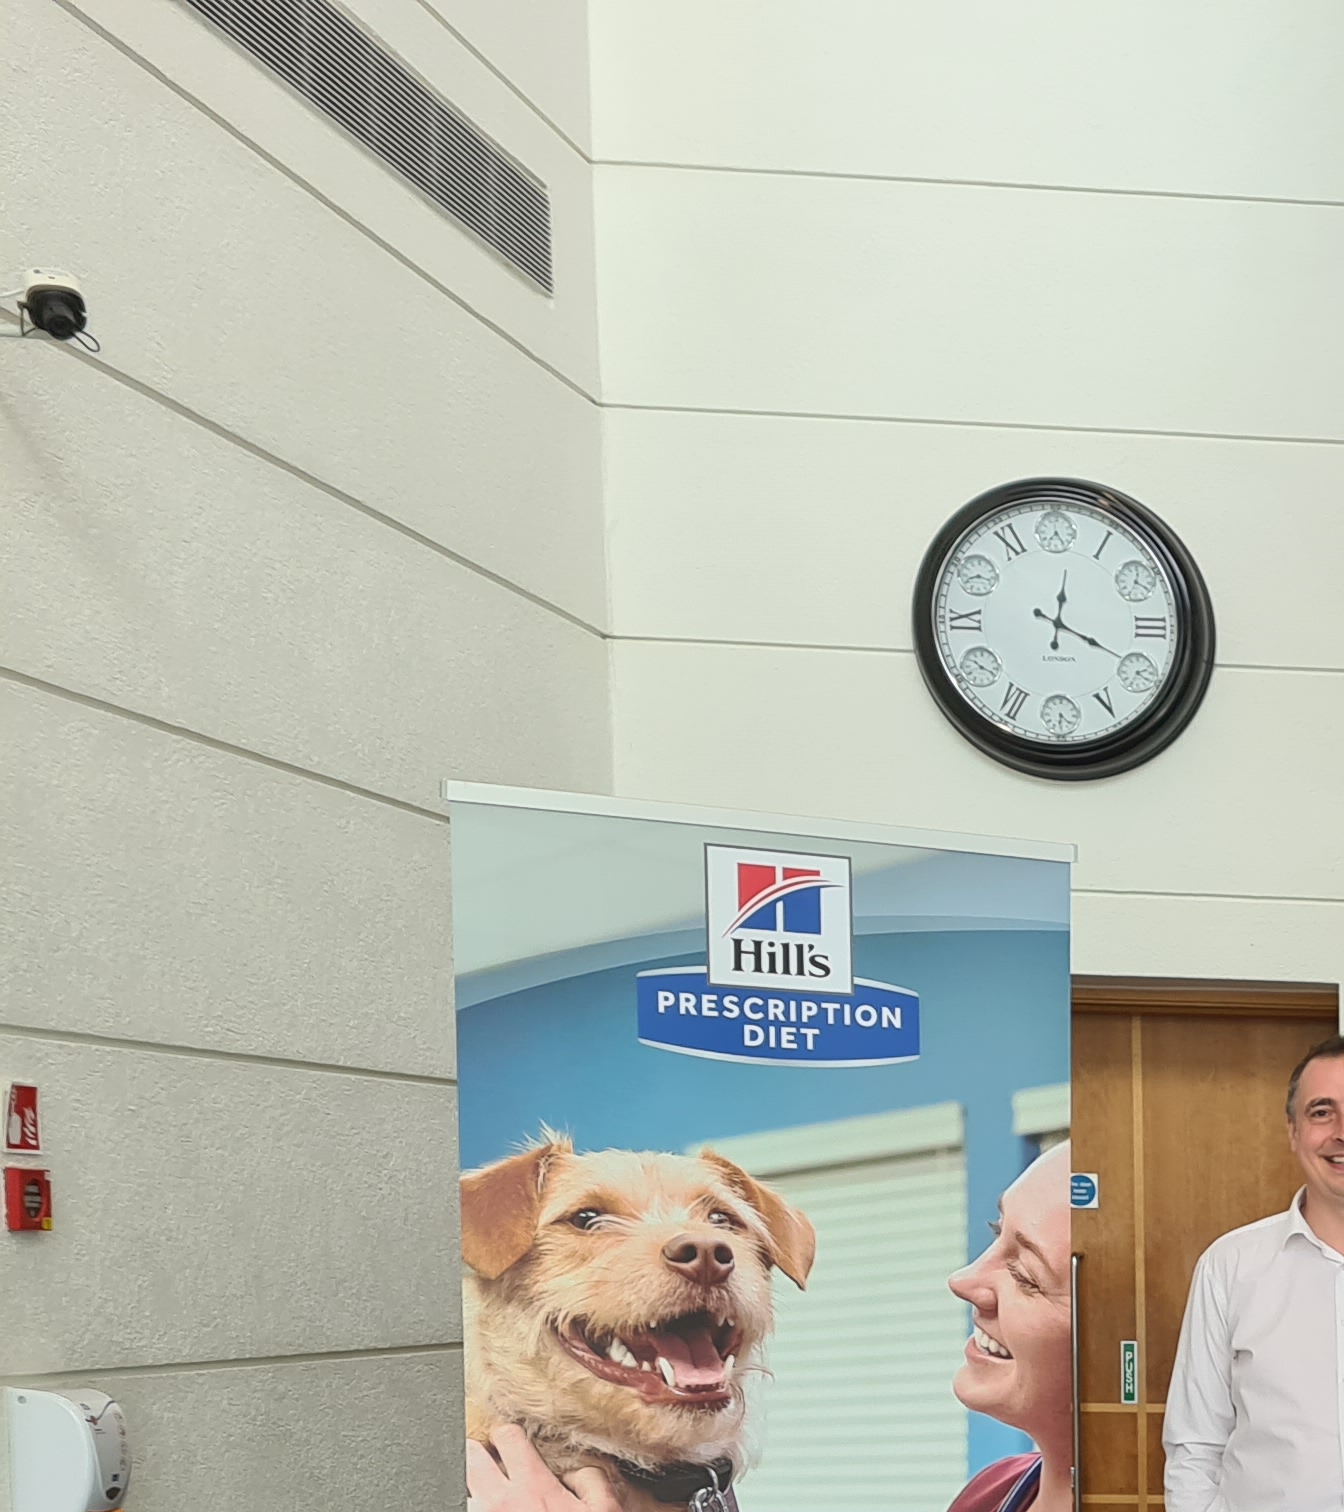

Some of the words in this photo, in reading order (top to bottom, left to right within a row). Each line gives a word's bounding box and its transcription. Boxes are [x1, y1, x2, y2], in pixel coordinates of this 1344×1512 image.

[730, 937, 831, 979] Hill's
[656, 990, 902, 1029] PRESCRIPTION
[742, 1024, 821, 1051] DIET
[1125, 1351, 1133, 1394] PUSH
